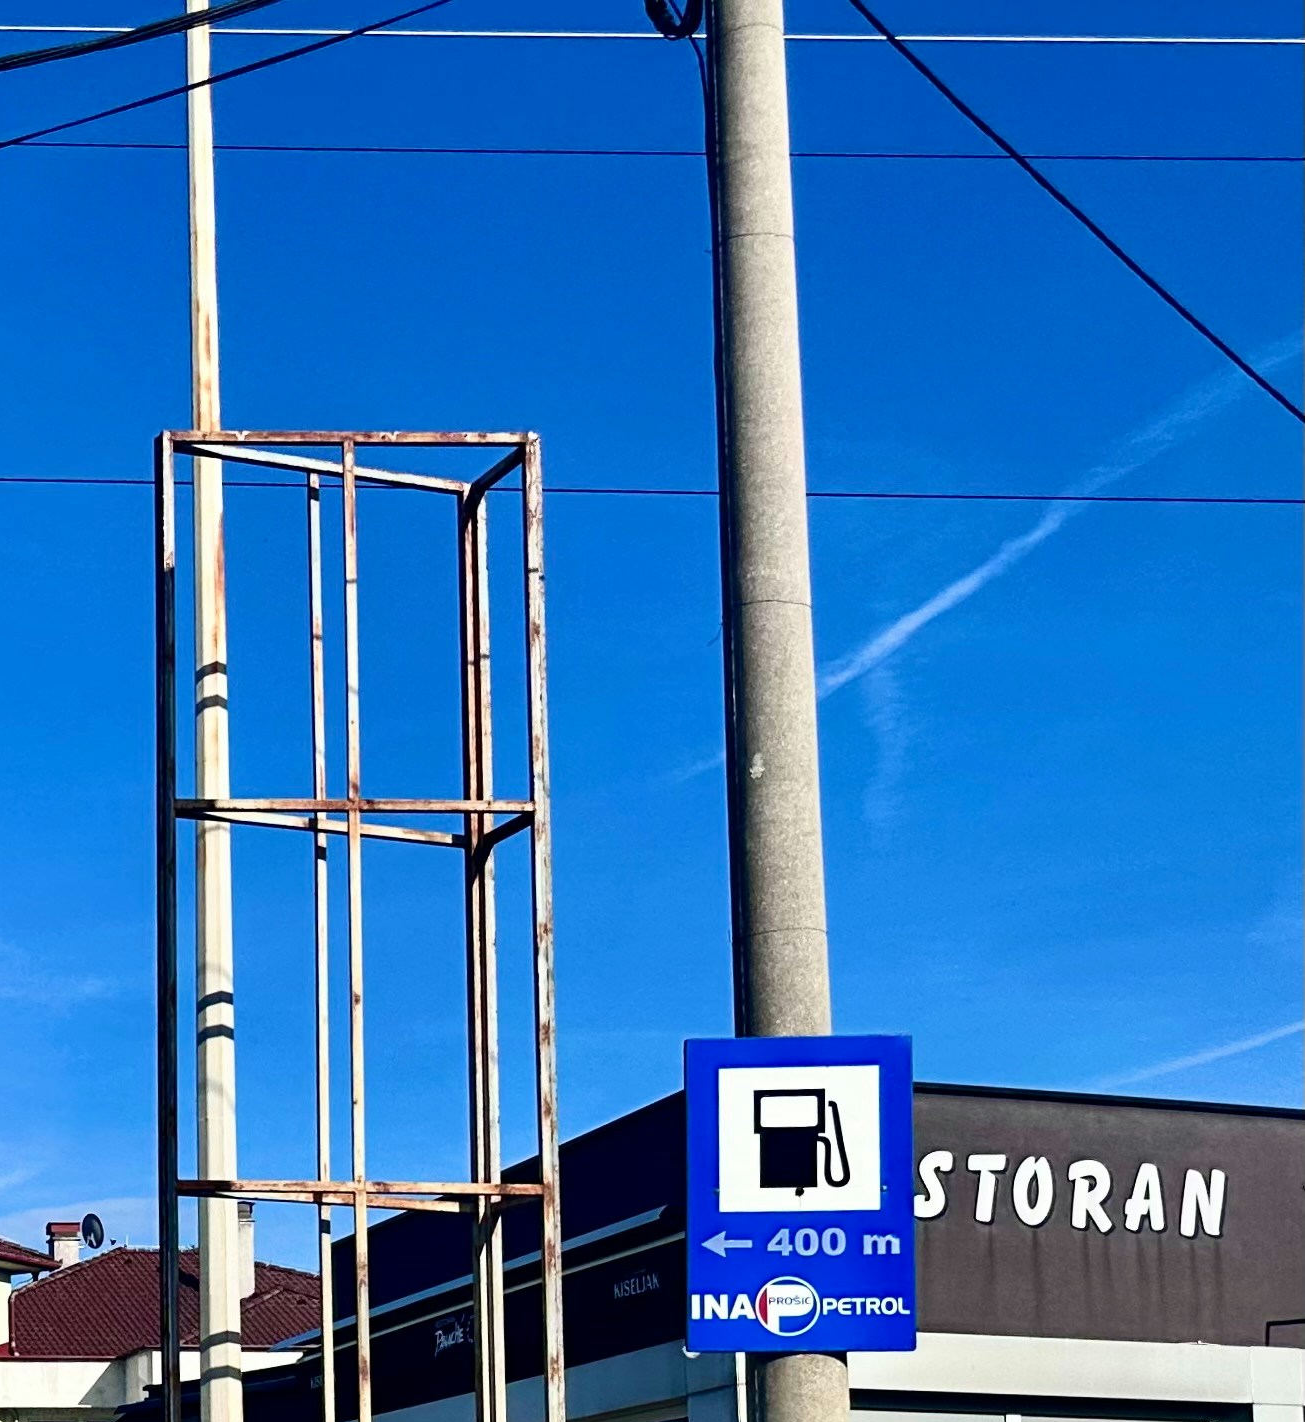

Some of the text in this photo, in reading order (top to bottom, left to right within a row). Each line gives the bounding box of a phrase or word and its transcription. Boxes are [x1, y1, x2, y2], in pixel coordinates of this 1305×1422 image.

[914, 1150, 1226, 1238] STORAN
[767, 1227, 901, 1257] 400 m
[613, 1272, 660, 1299] KISELJAK
[691, 1293, 911, 1320] INA PETROL
